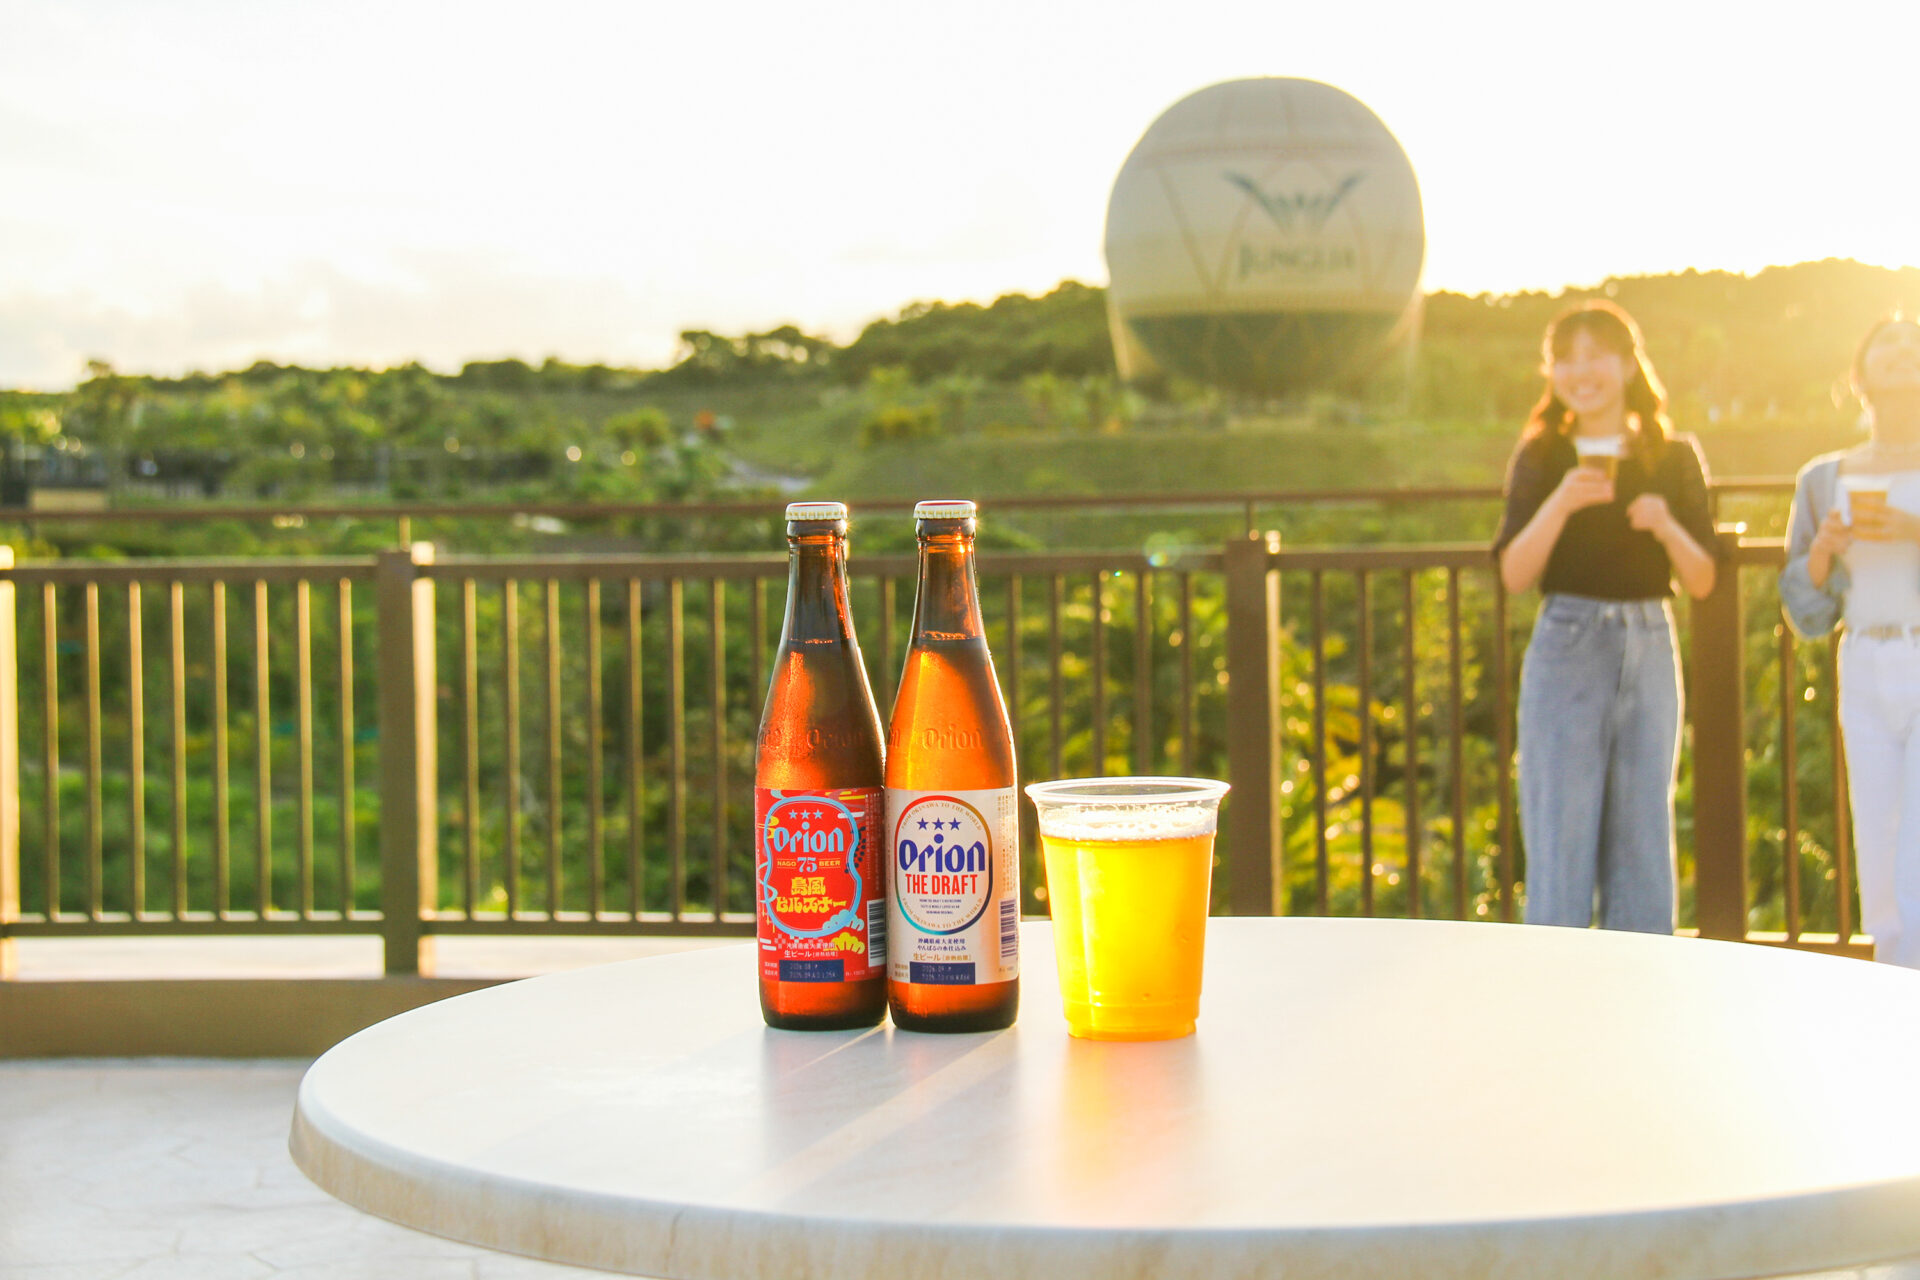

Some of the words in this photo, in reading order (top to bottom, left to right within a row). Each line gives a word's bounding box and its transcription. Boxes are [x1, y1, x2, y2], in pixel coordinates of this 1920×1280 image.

[773, 821, 844, 853] Orion
[797, 857, 817, 873] 75
[899, 833, 986, 873] Orion
[905, 873, 929, 895] THE
[931, 874, 978, 895] DRAFT
